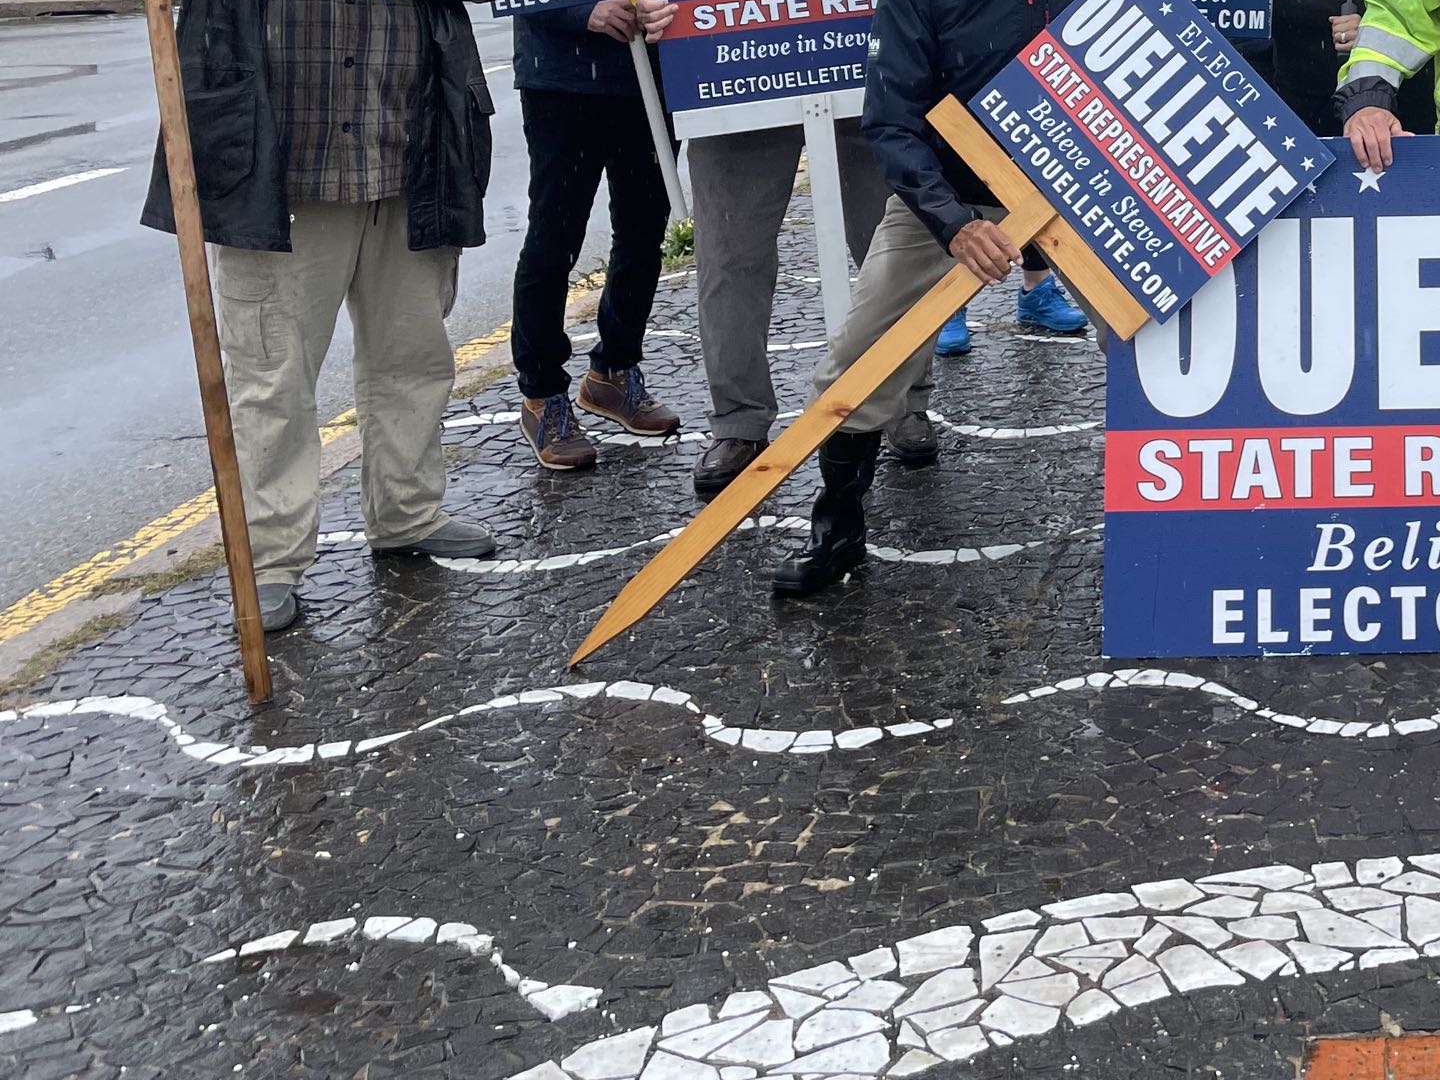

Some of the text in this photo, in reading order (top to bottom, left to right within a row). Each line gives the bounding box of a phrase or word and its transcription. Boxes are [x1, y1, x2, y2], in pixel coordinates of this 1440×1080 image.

[698, 63, 867, 100] ELECTOUELLETTE.
[716, 38, 791, 64] Believe
[797, 34, 817, 54] in
[822, 31, 871, 51] Stev
[1175, 20, 1261, 109] ELECT
[1026, 98, 1176, 259] Believe in Steve!
[1028, 41, 1231, 269] STATE REPRESENTATIVE
[980, 88, 1179, 314] ELECTOUELLETTE.COM
[1136, 435, 1376, 502] STATE
